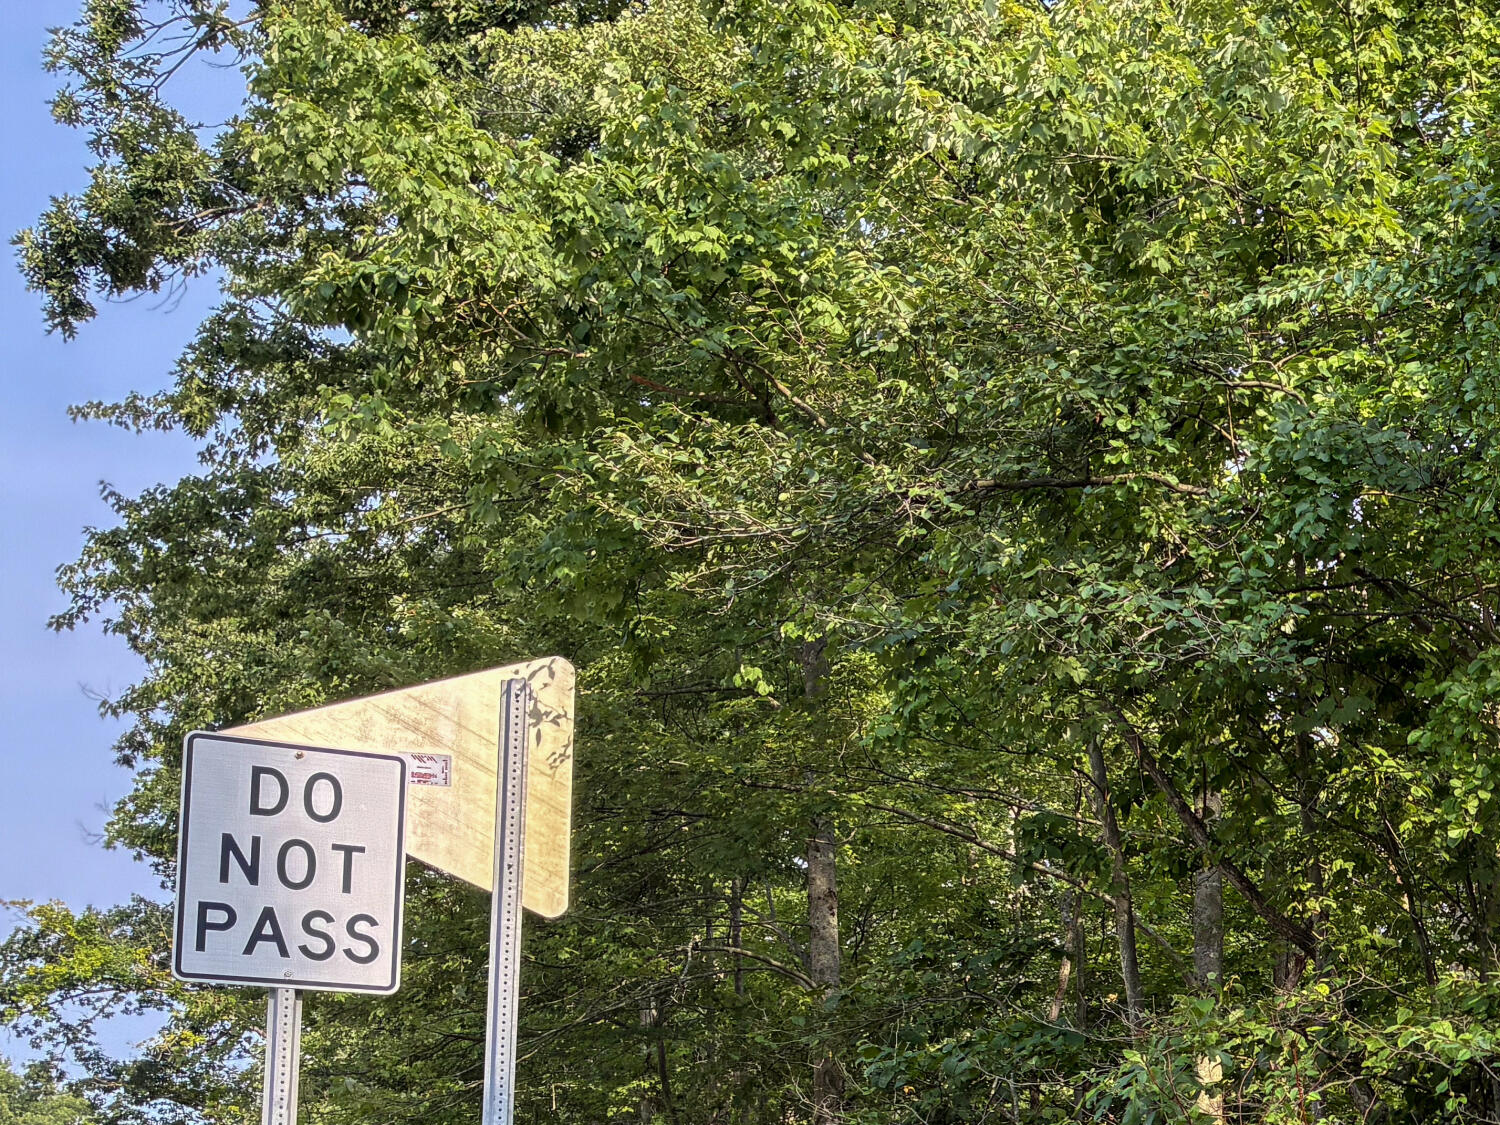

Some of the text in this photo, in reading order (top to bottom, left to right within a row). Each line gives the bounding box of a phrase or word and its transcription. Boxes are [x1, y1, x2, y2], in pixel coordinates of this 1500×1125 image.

[249, 765, 343, 823] DO
[219, 832, 365, 894] NOT
[195, 901, 380, 964] PASS
